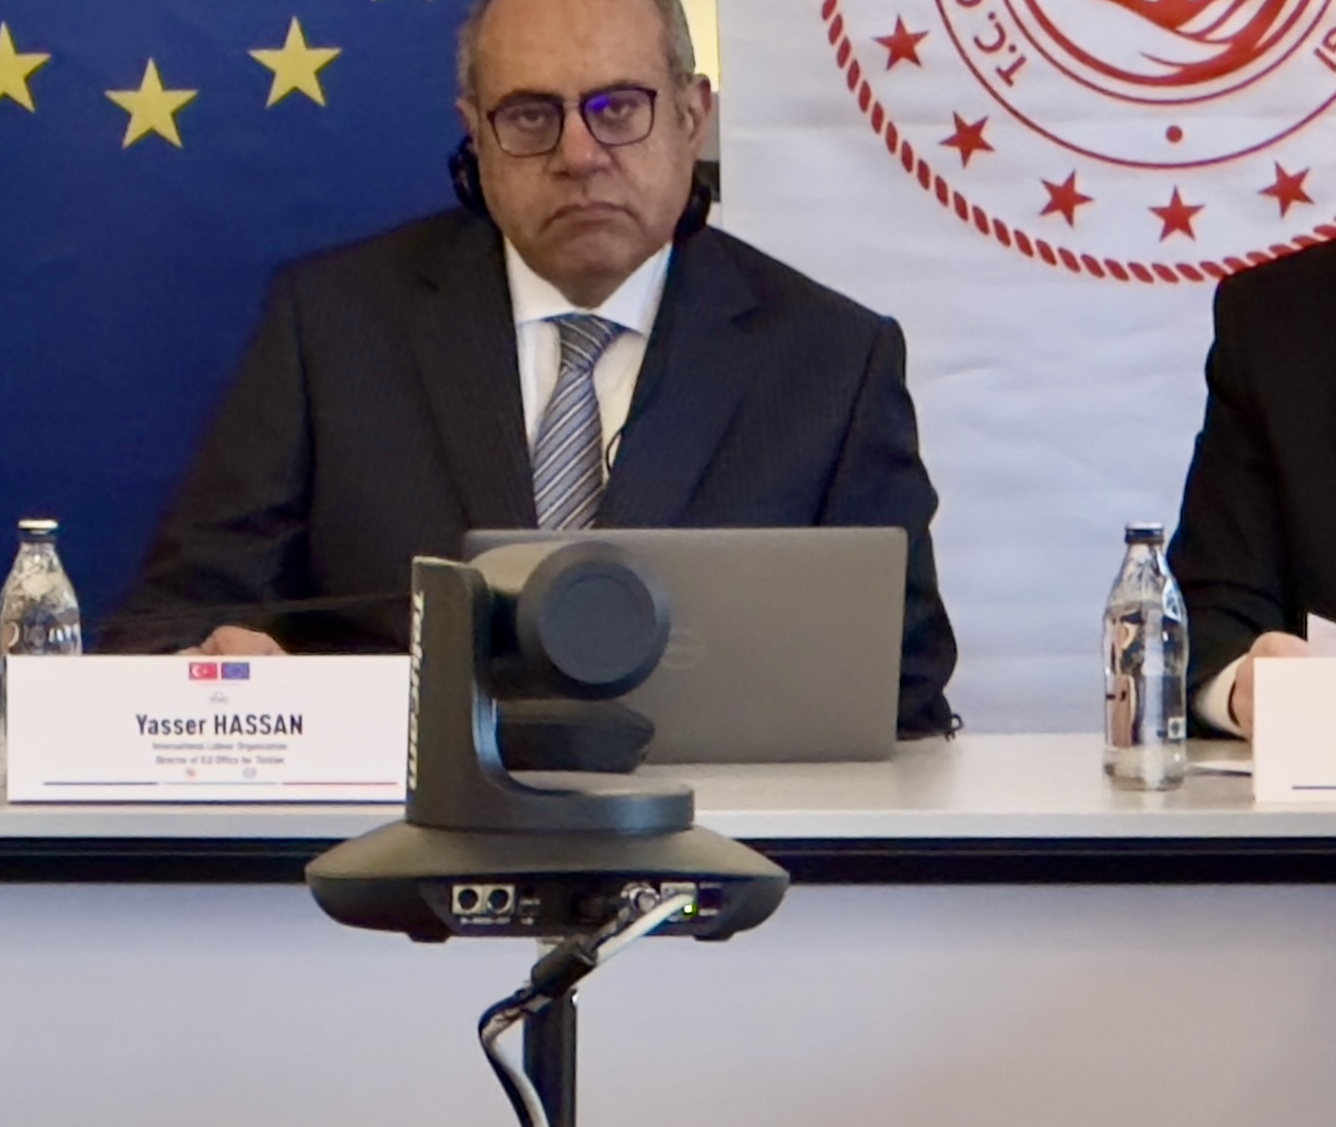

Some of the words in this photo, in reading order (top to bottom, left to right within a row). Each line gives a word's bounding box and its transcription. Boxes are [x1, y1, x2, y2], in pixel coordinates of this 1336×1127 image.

[972, 10, 1027, 87] T.C.
[134, 713, 207, 737] Yasser
[213, 713, 304, 736] HASSAN
